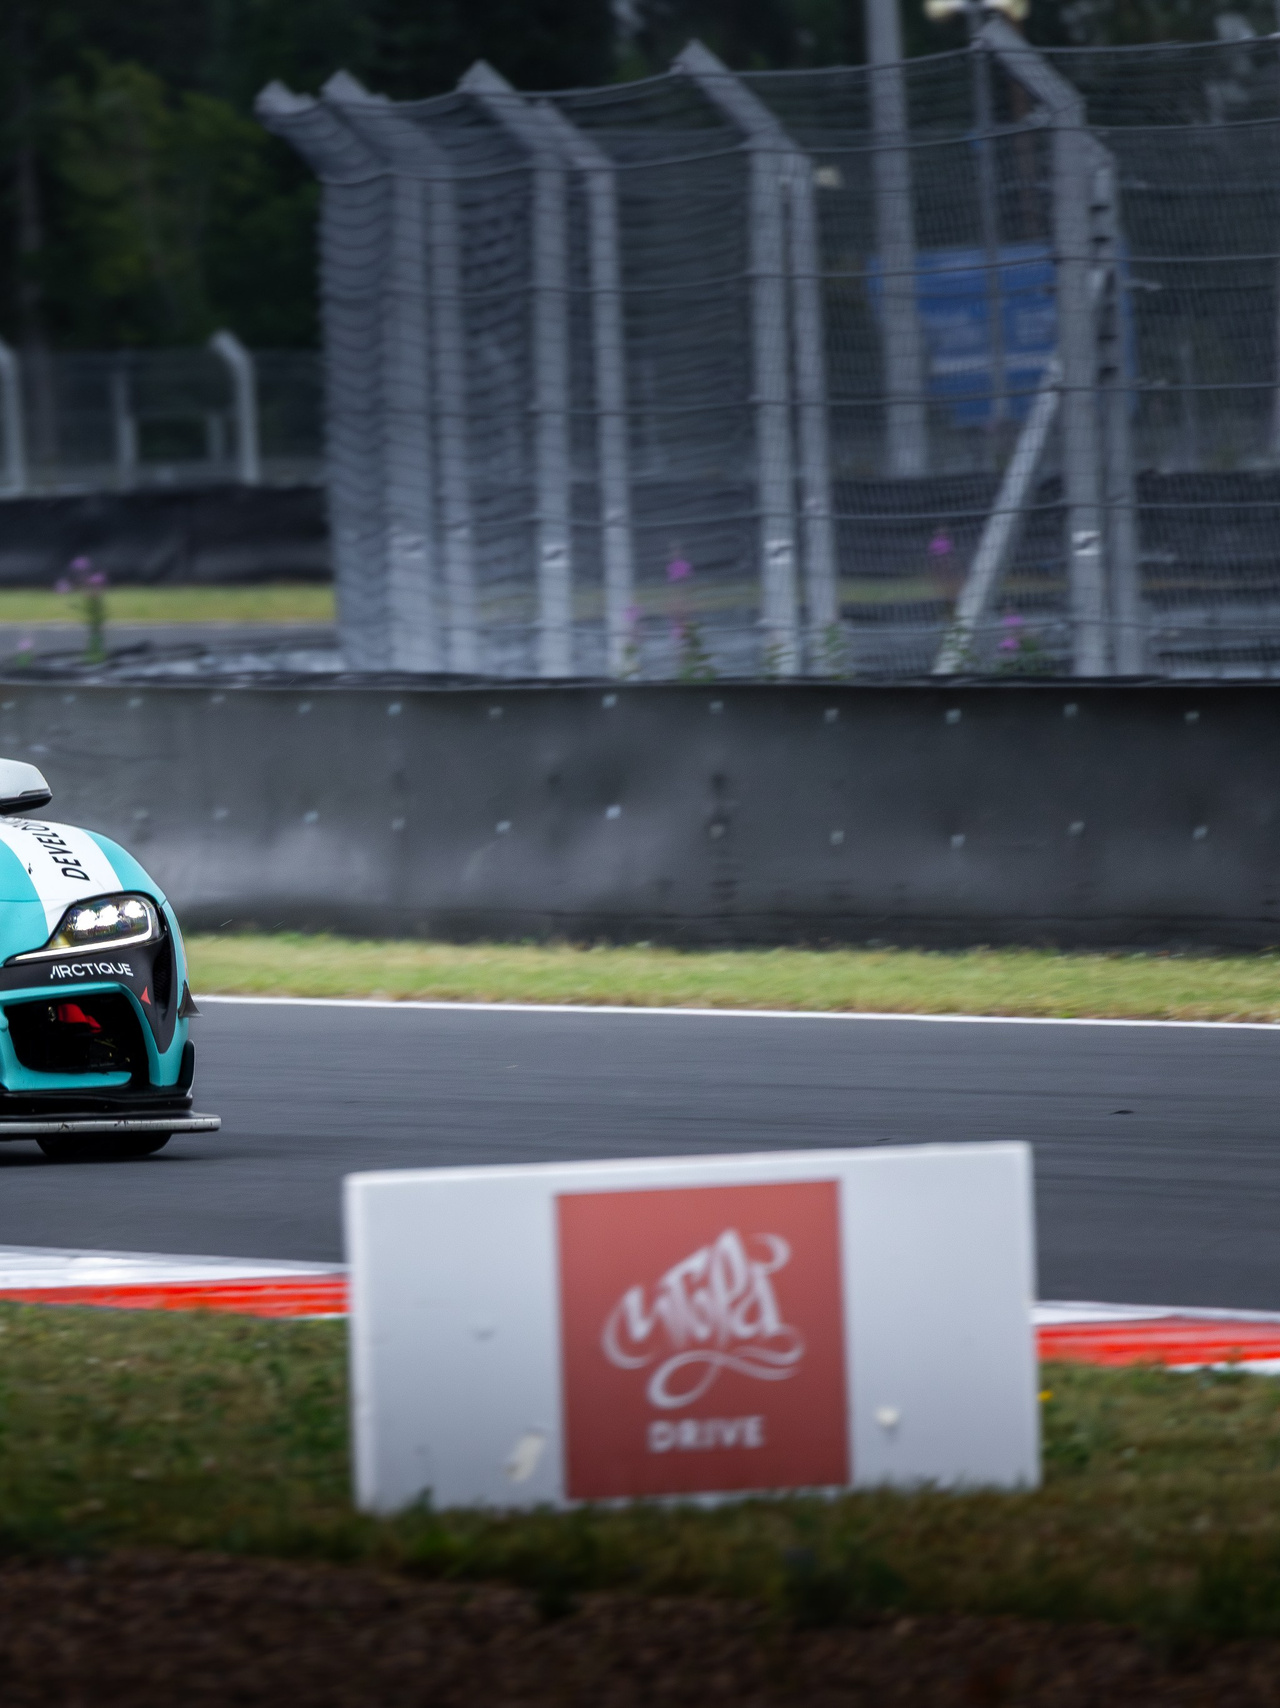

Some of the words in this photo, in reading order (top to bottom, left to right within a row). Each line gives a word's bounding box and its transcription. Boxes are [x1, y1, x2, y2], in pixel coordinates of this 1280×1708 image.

[14, 822, 90, 881] DEVELO
[50, 962, 134, 979] ARCTIQUE
[649, 1415, 764, 1451] DRIVE
